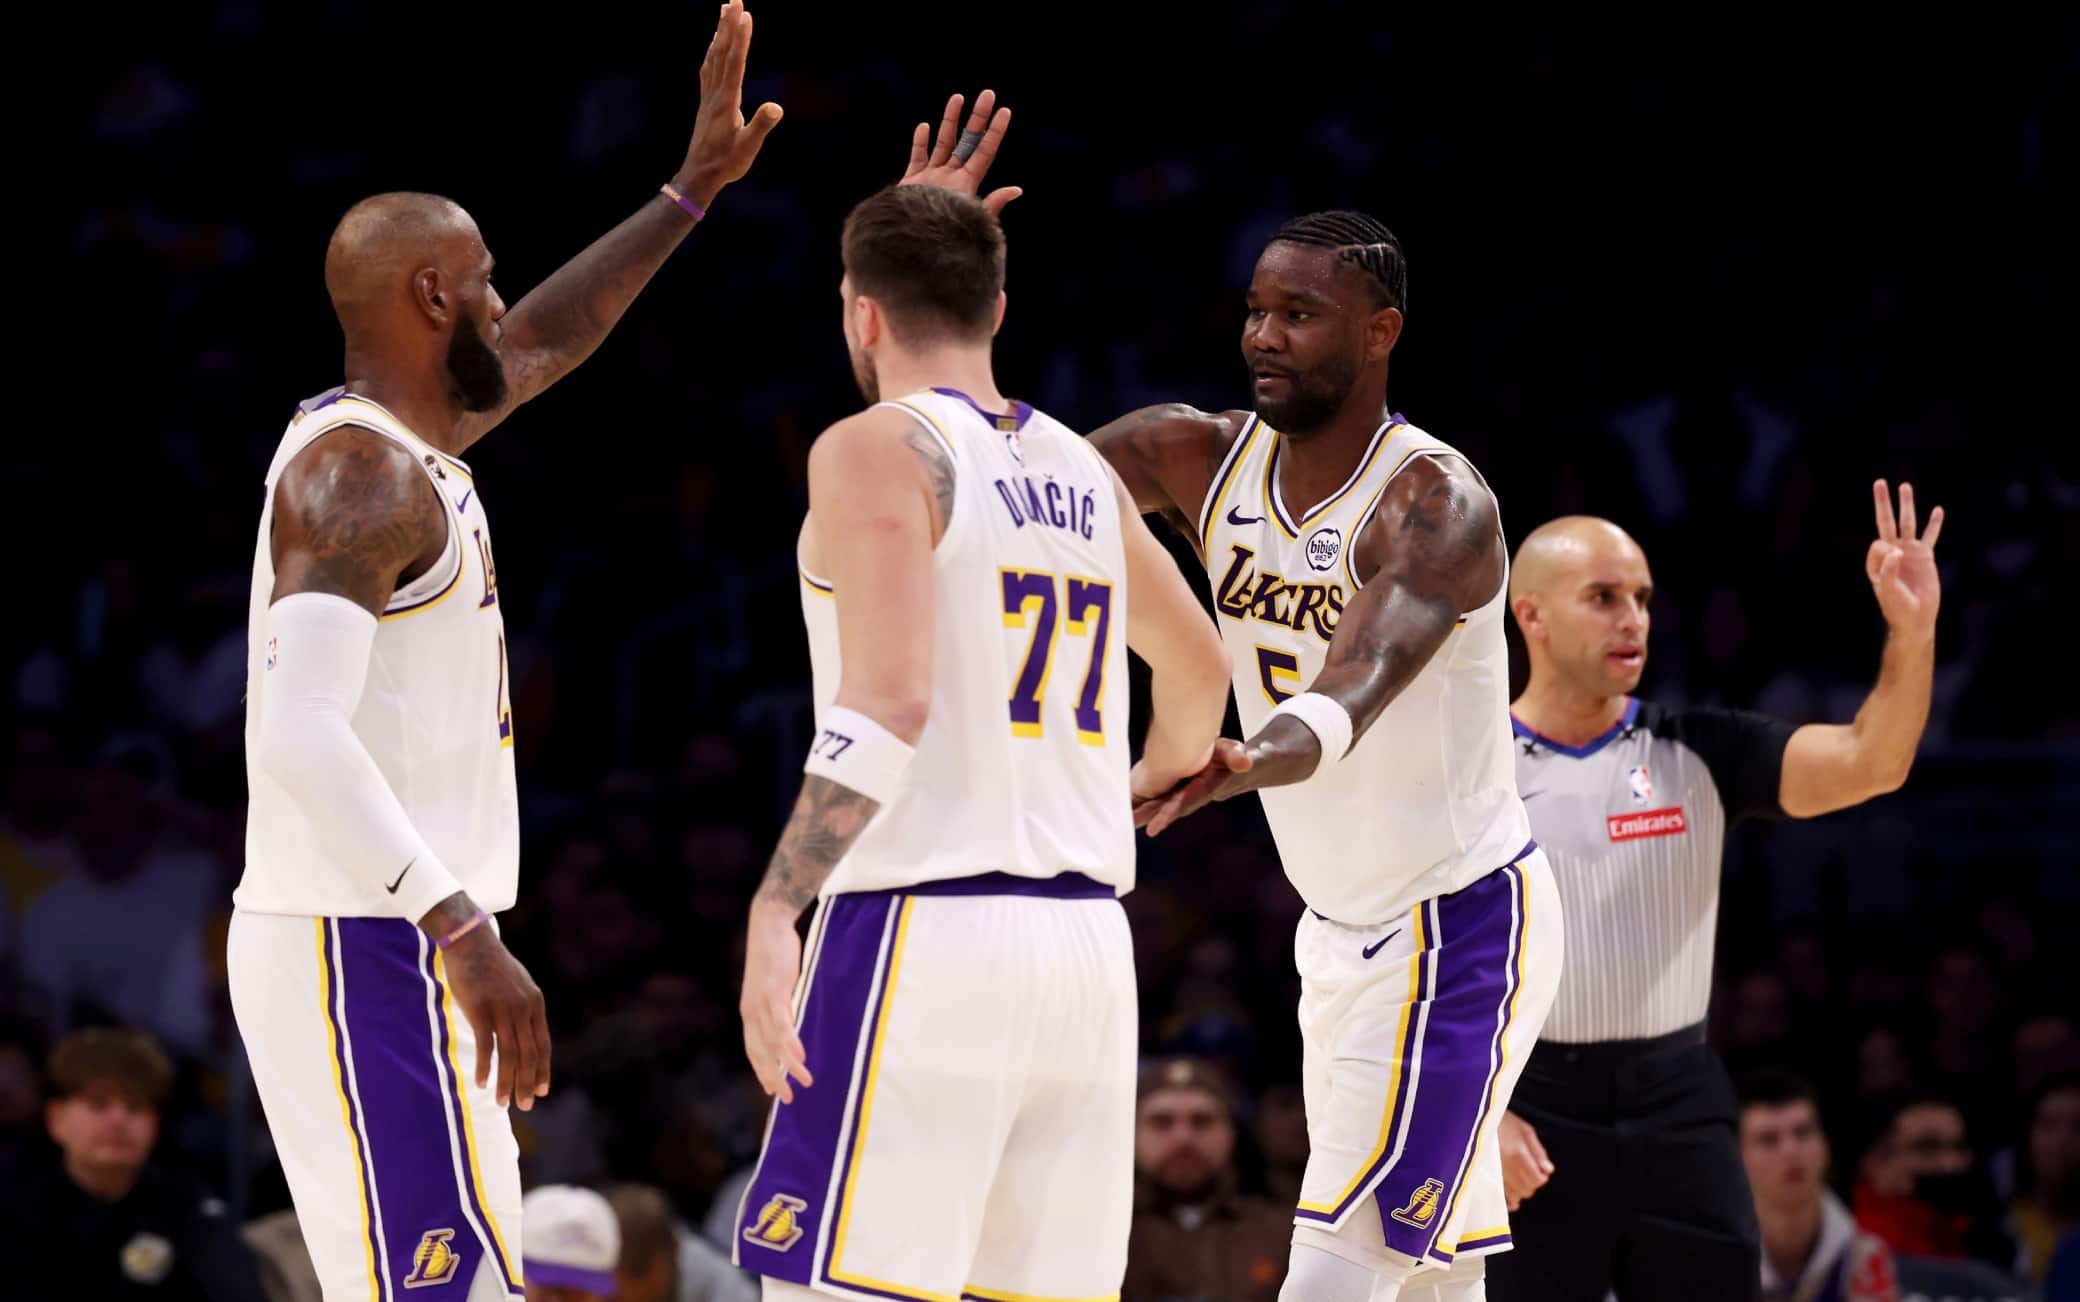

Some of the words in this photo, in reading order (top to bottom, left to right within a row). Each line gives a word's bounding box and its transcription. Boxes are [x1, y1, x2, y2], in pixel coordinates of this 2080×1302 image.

[1310, 540, 1339, 559] bibigo
[998, 566, 1115, 748] 77
[814, 728, 855, 763] 77
[1609, 812, 1683, 837] Emirates
